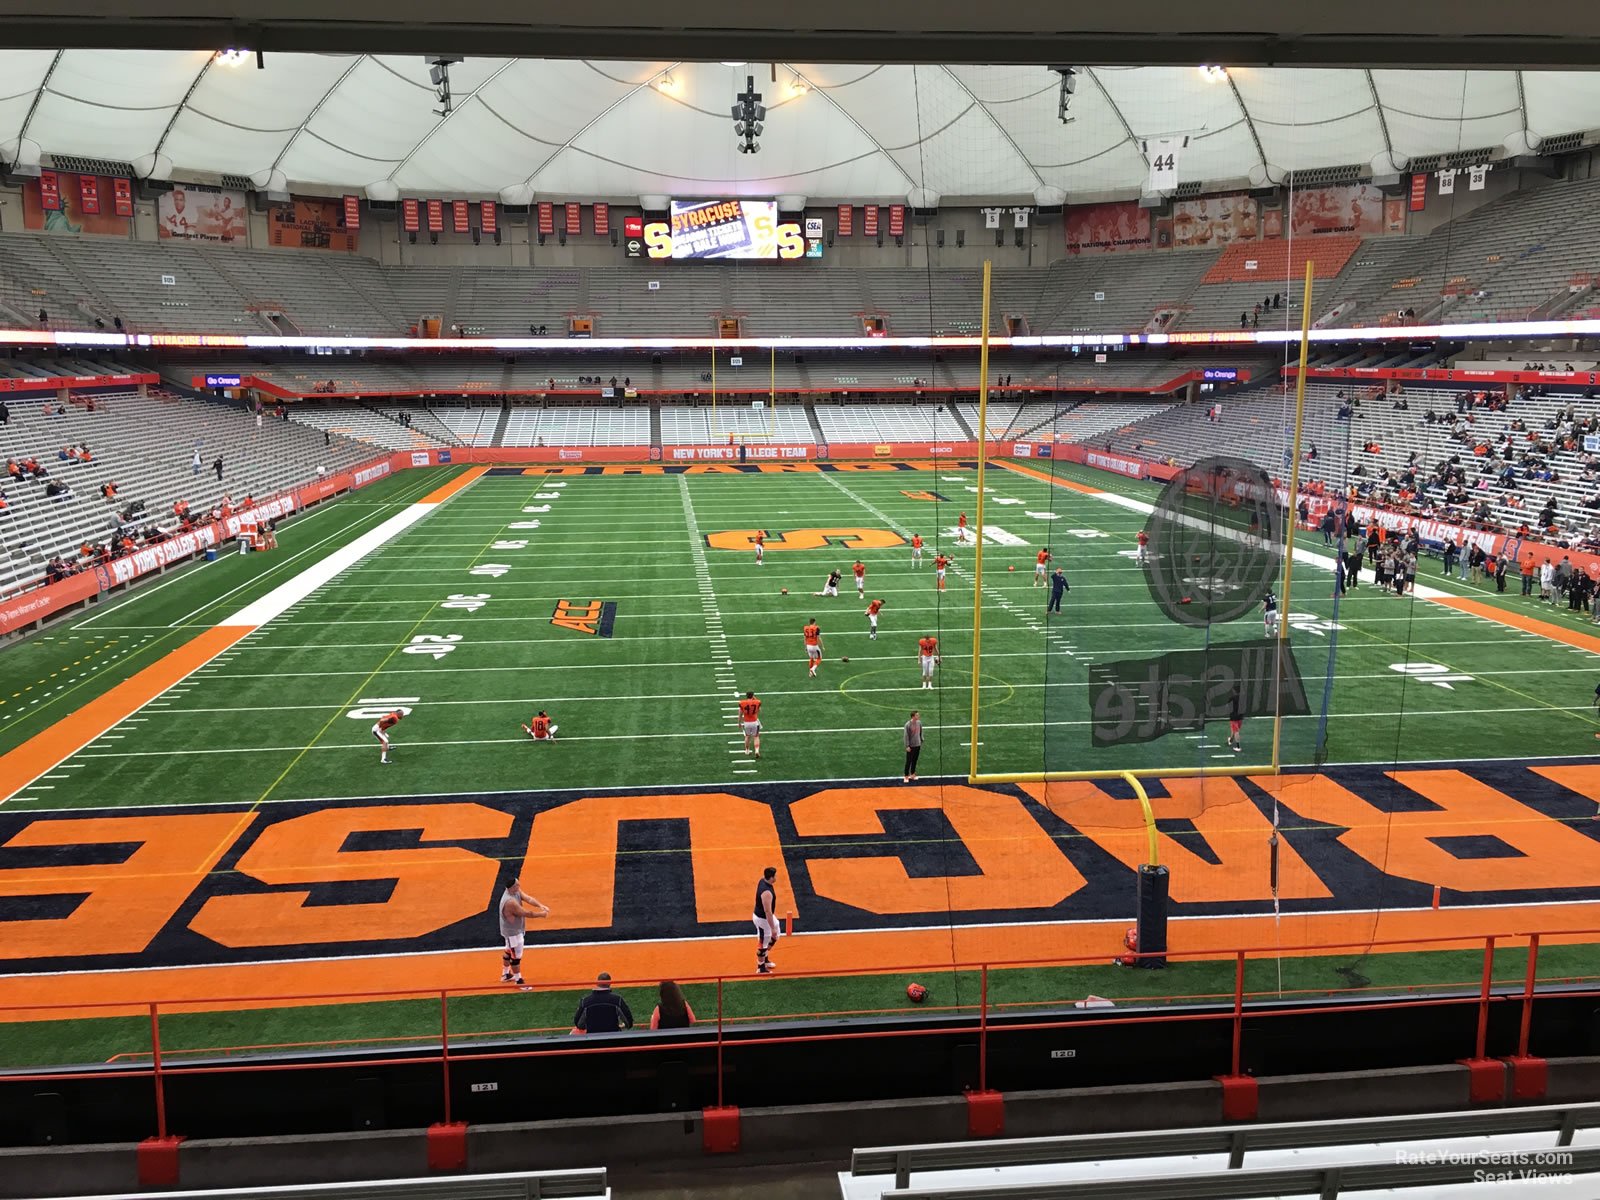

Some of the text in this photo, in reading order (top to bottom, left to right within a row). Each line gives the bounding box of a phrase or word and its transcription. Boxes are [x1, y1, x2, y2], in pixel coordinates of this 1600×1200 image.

[1154, 154, 1174, 172] 44
[1442, 178, 1452, 187] 88
[672, 201, 741, 231] SYRACUSE
[1113, 238, 1151, 246] CHAMPIONS
[152, 335, 200, 346] SYRACUSE
[1169, 332, 1212, 344] SYRACUSE
[207, 377, 240, 385] Go Orange
[673, 449, 695, 458] NEW
[697, 448, 733, 458] YORK'S
[781, 448, 806, 457] TEAM
[1352, 506, 1496, 556] NEW YORK'S COLLEGE TEAM
[112, 526, 215, 586] NEW YORK'S COLLEGE TEAM
[6, 596, 50, 622] Time Warner Cable
[402, 634, 464, 654] 20
[346, 696, 420, 719] 10
[744, 704, 757, 714] 47
[535, 720, 544, 731] 18
